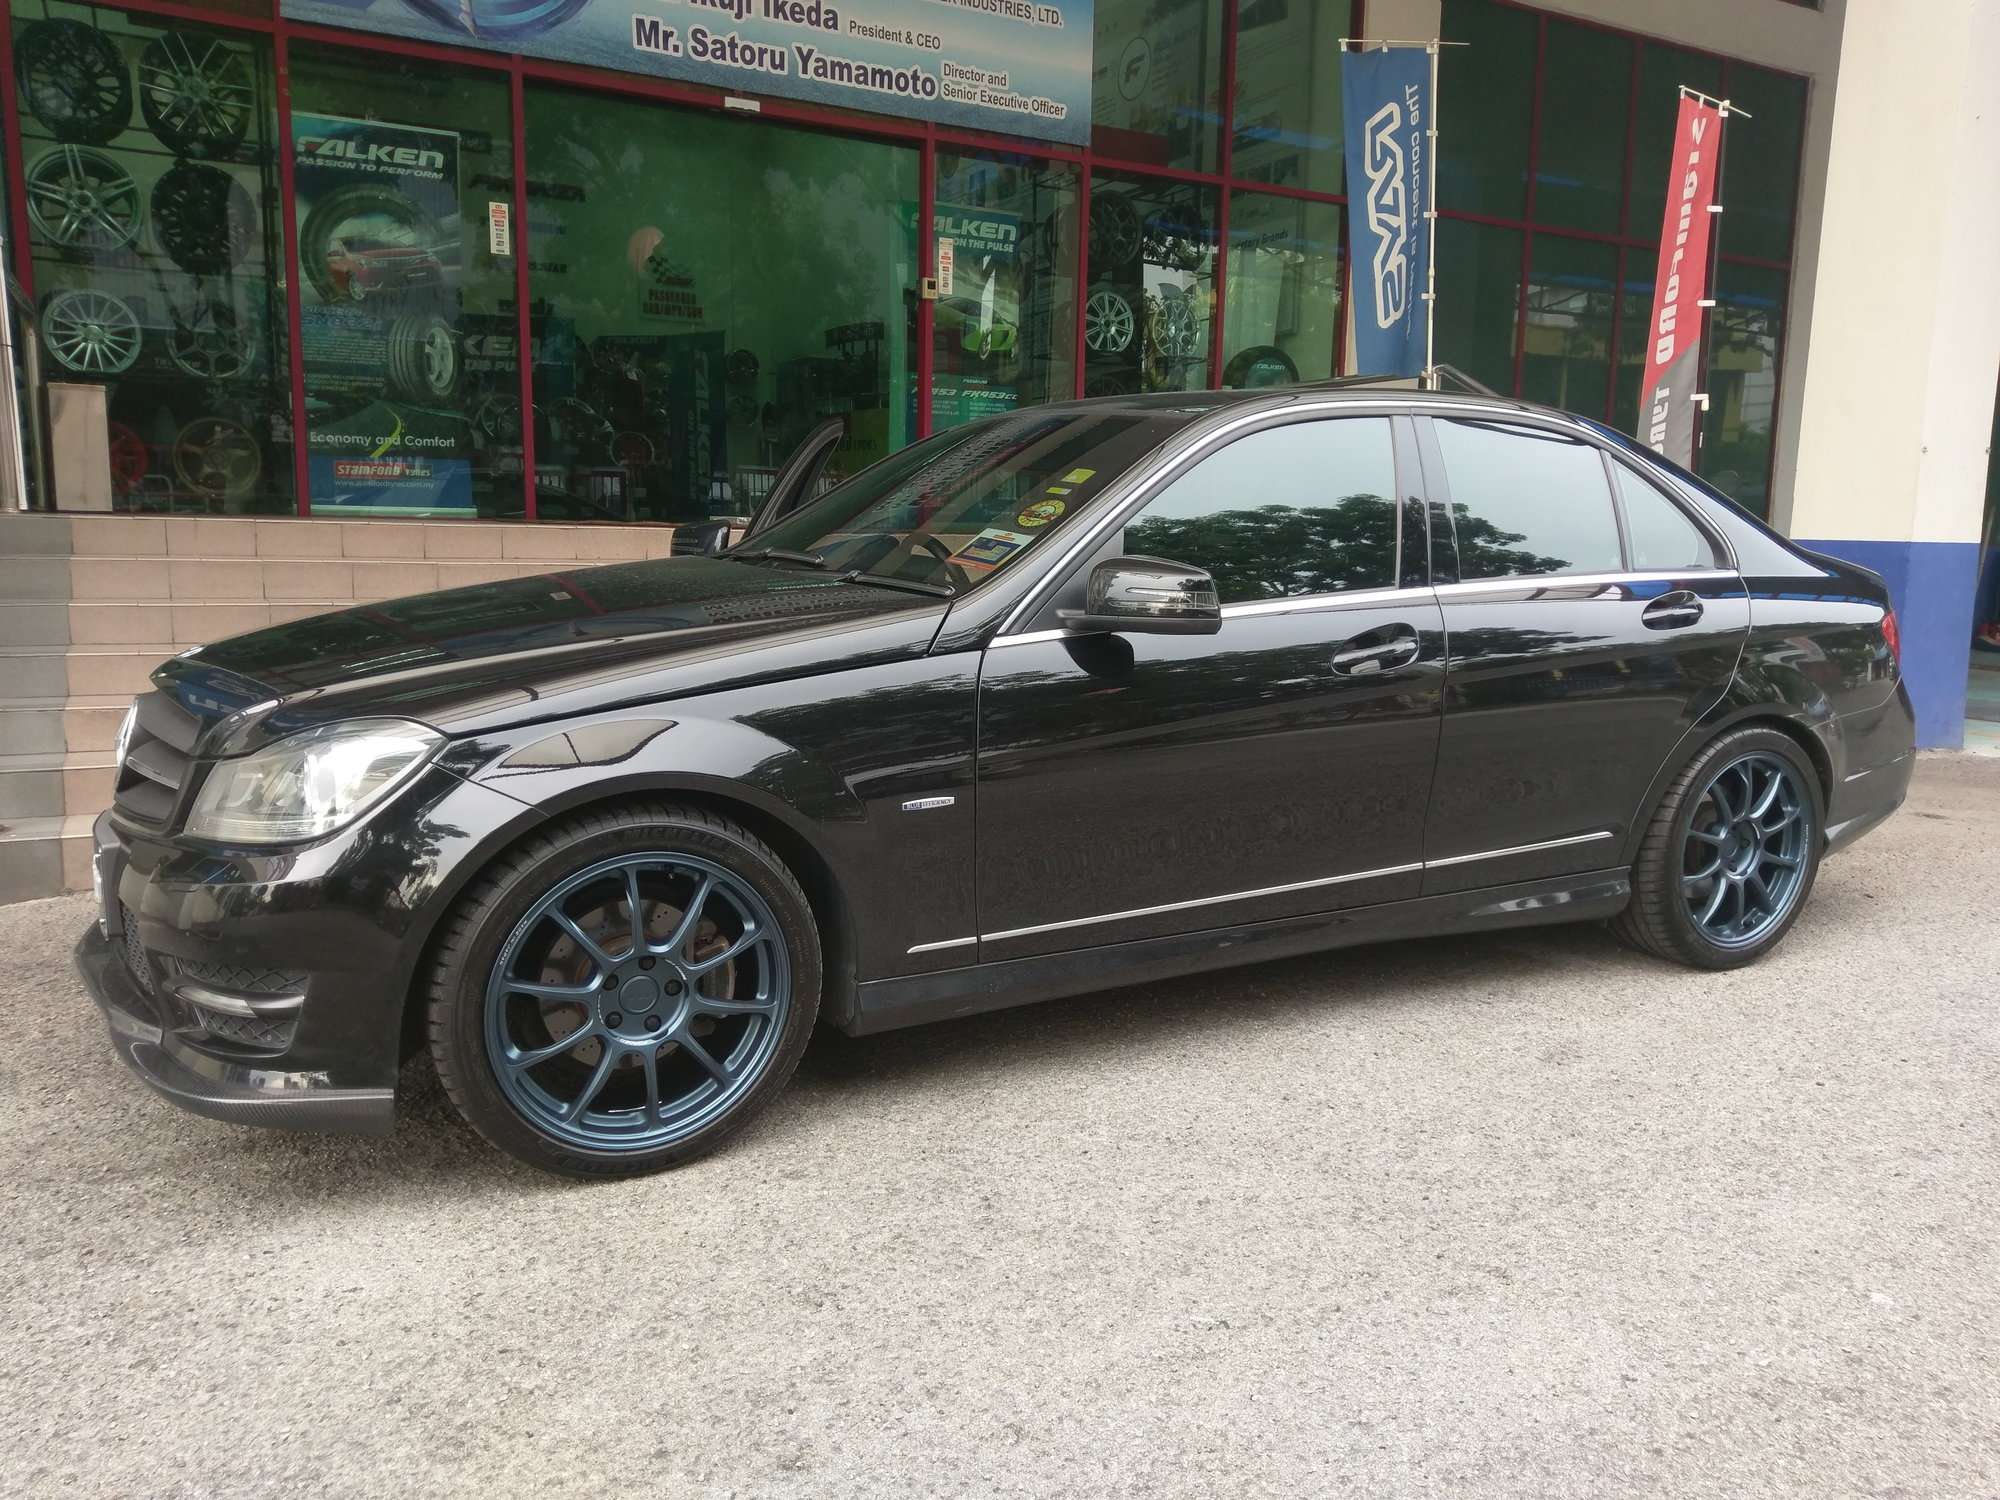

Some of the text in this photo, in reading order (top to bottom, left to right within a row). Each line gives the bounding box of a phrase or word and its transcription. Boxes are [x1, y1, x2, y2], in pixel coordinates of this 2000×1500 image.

[764, 0, 839, 31] Ikeda
[1038, 7, 1063, 26] LTD.
[849, 20, 942, 50] President & CEO
[635, 17, 937, 97] Mr. Satoru Yamamoto
[943, 63, 1007, 86] Director and
[943, 84, 1065, 117] Senior Executive Officer
[296, 135, 444, 169] FALKEN
[296, 156, 443, 179] PASSION TO PERFORM
[968, 239, 985, 249] THE
[987, 241, 1014, 253] PULSE
[310, 432, 455, 447] Economy and Comfort
